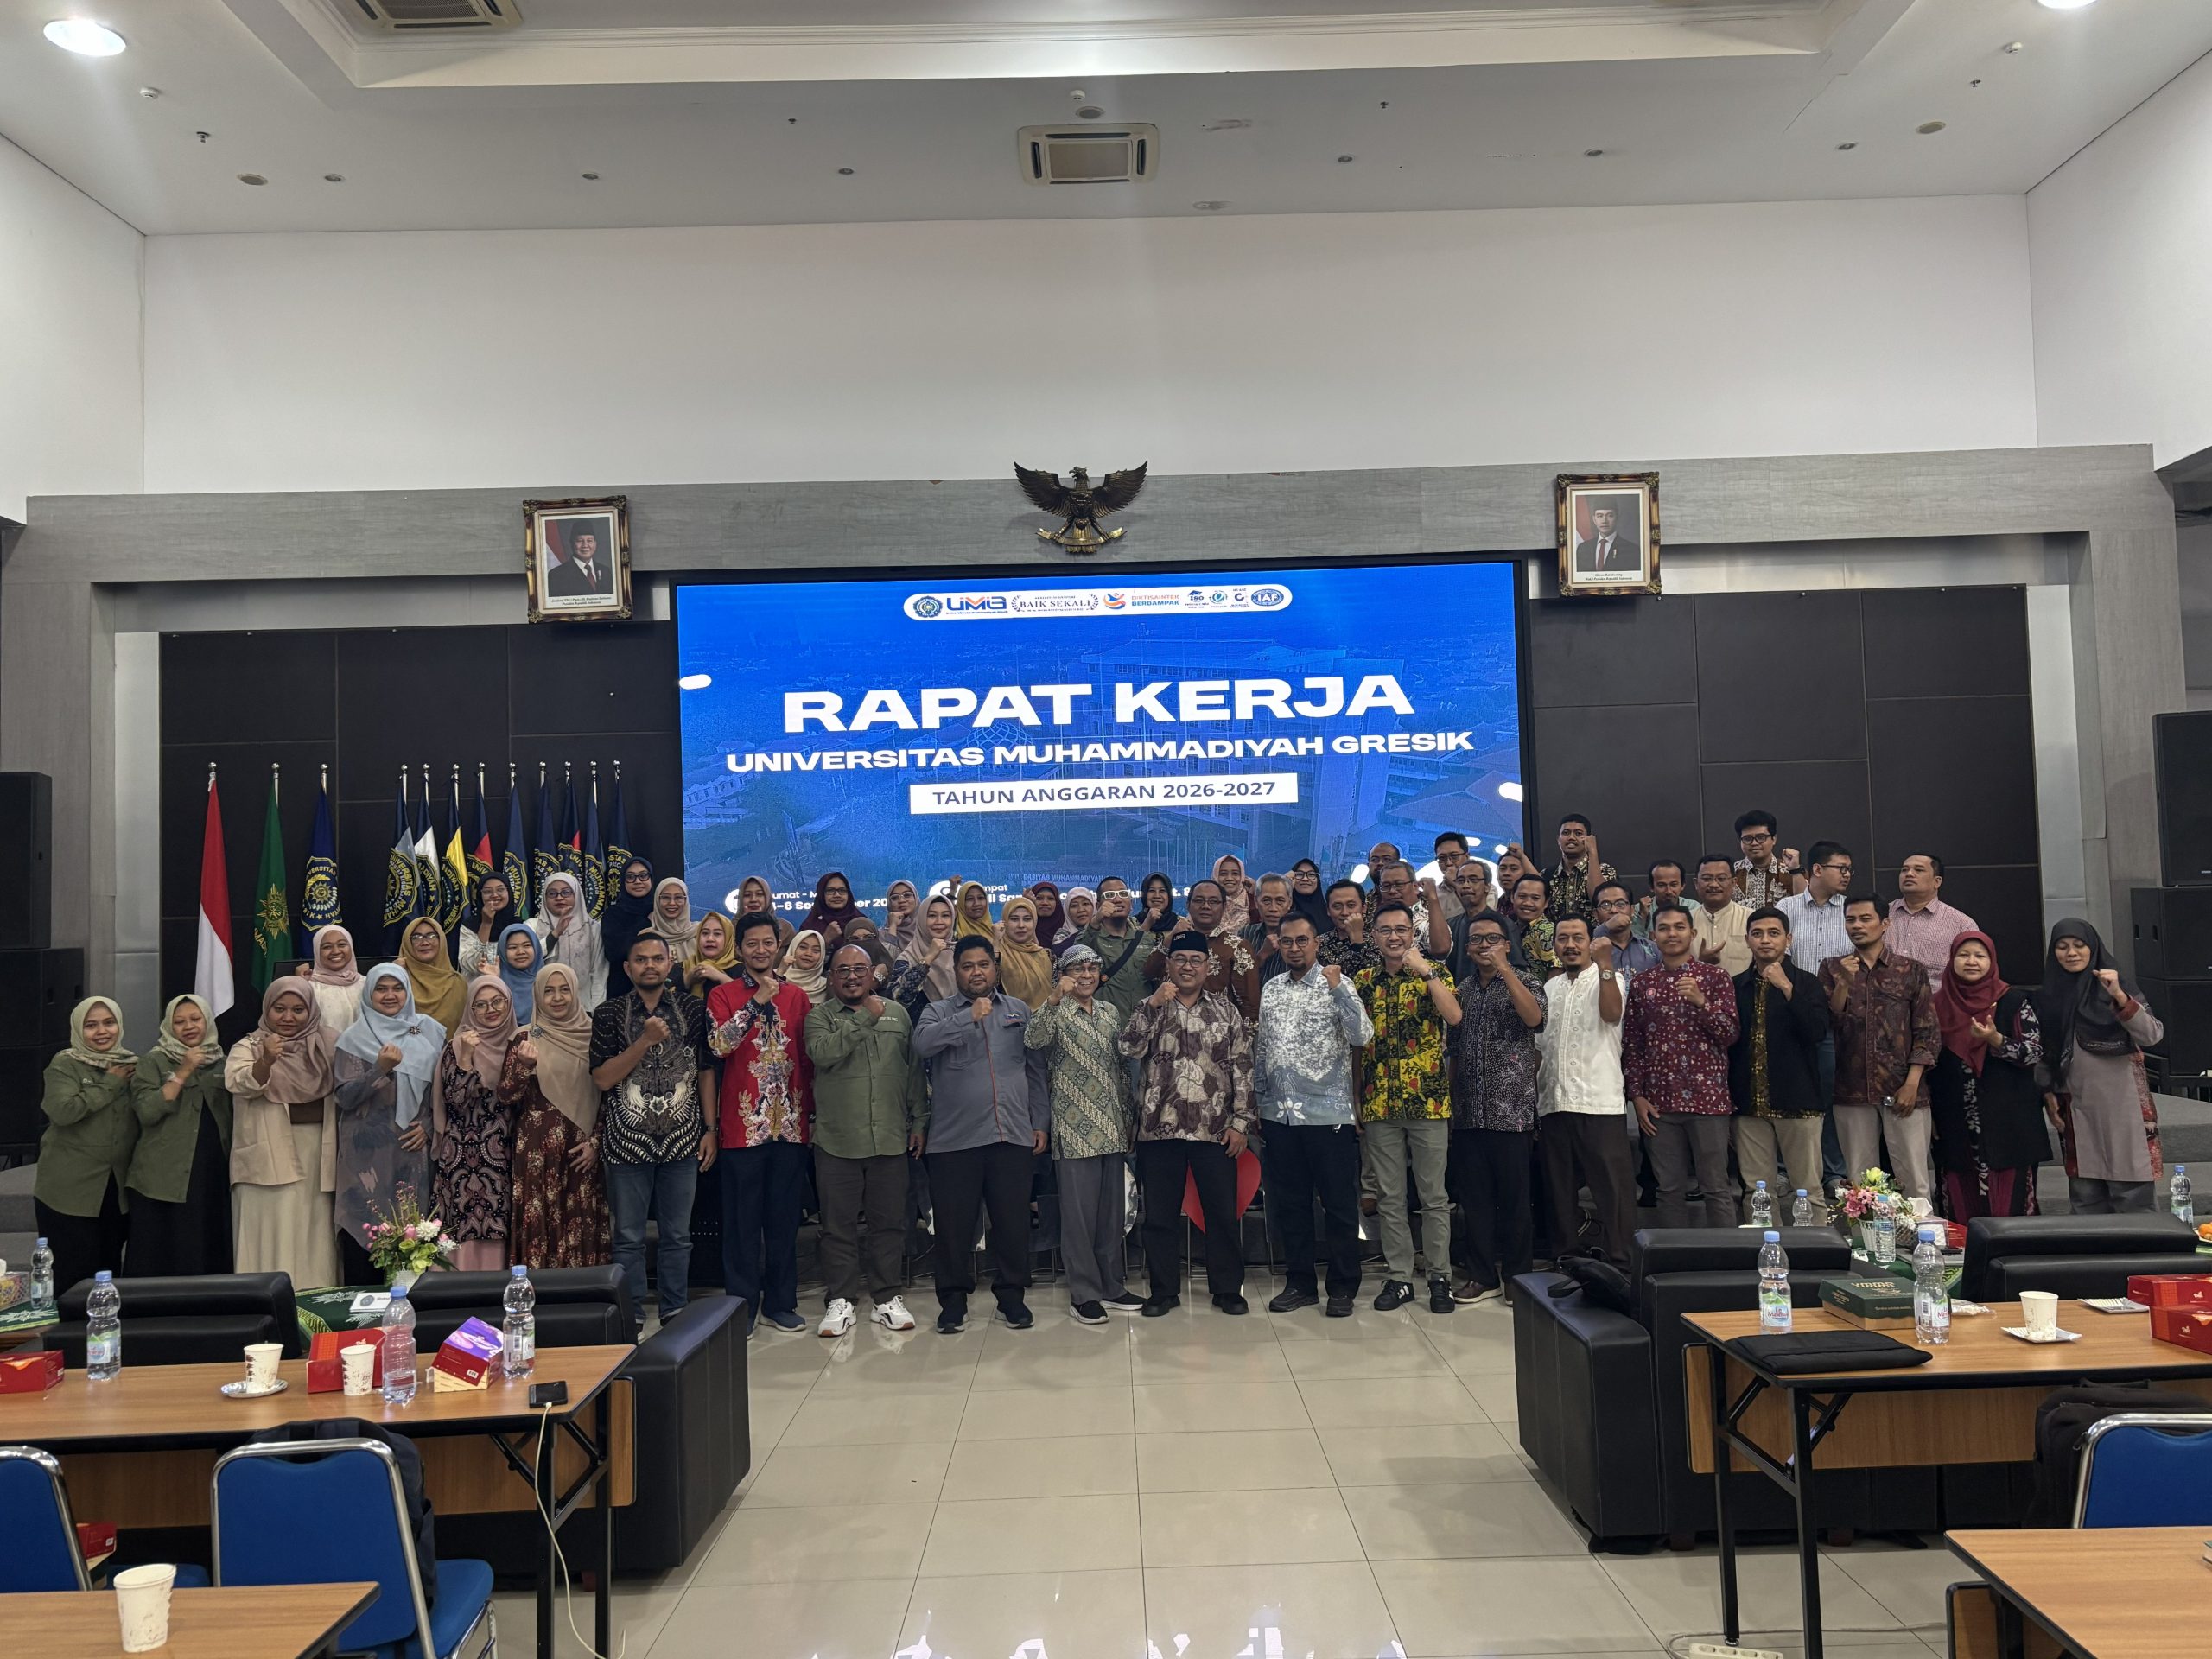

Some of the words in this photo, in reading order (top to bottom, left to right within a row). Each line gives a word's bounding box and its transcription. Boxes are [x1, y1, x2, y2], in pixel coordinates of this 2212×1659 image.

[947, 596, 1007, 610] UMG
[784, 684, 1093, 734] RAPAT
[1115, 674, 1415, 723] KERJA
[727, 747, 985, 772] UNIVERSITAS
[994, 736, 1324, 765] MUHAMMADIYAH
[1332, 731, 1474, 754] GRESIK
[932, 790, 1014, 805] TAHUN
[1021, 785, 1155, 803] ANGGARAN
[1163, 782, 1275, 798] 2026-2027
[772, 891, 800, 899] umat
[985, 884, 1008, 893] mpat
